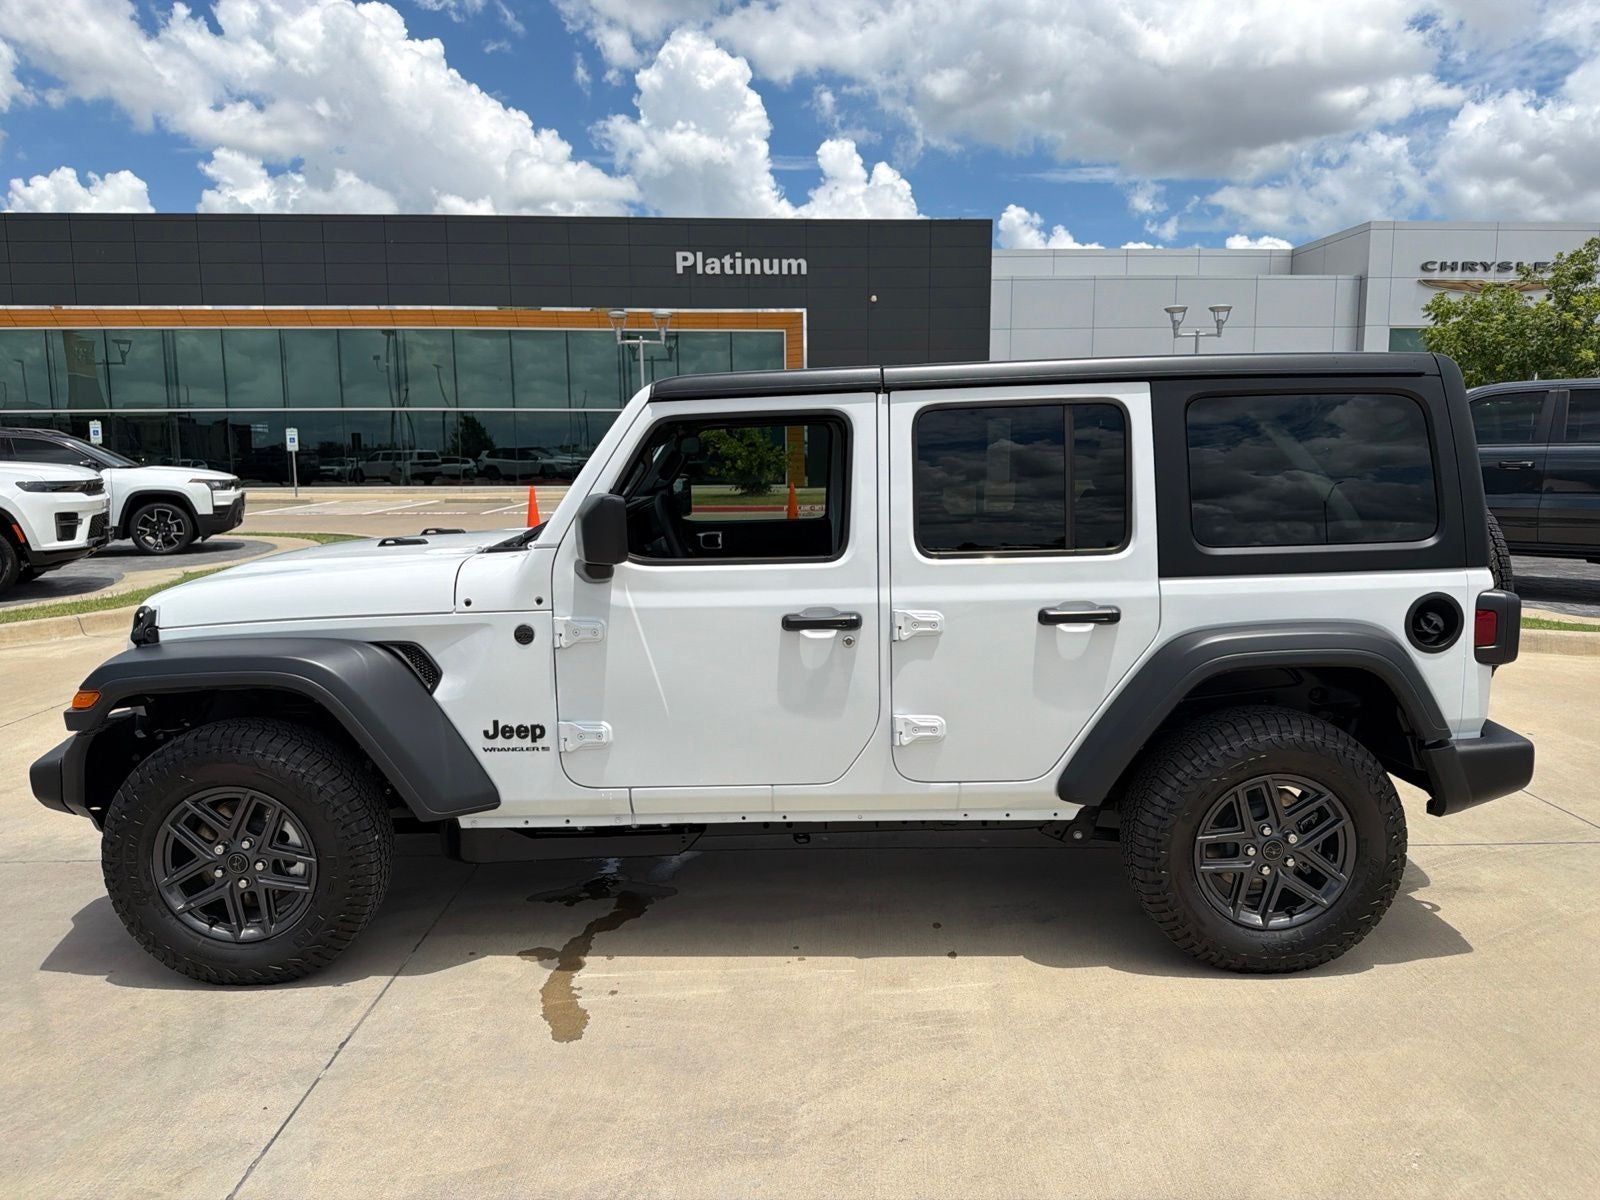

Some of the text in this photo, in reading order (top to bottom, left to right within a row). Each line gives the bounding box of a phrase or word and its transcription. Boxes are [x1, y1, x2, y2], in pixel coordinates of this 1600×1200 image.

[675, 251, 808, 275] Platinum
[1420, 260, 1558, 273] CHRYSLE
[482, 719, 546, 743] Jeep
